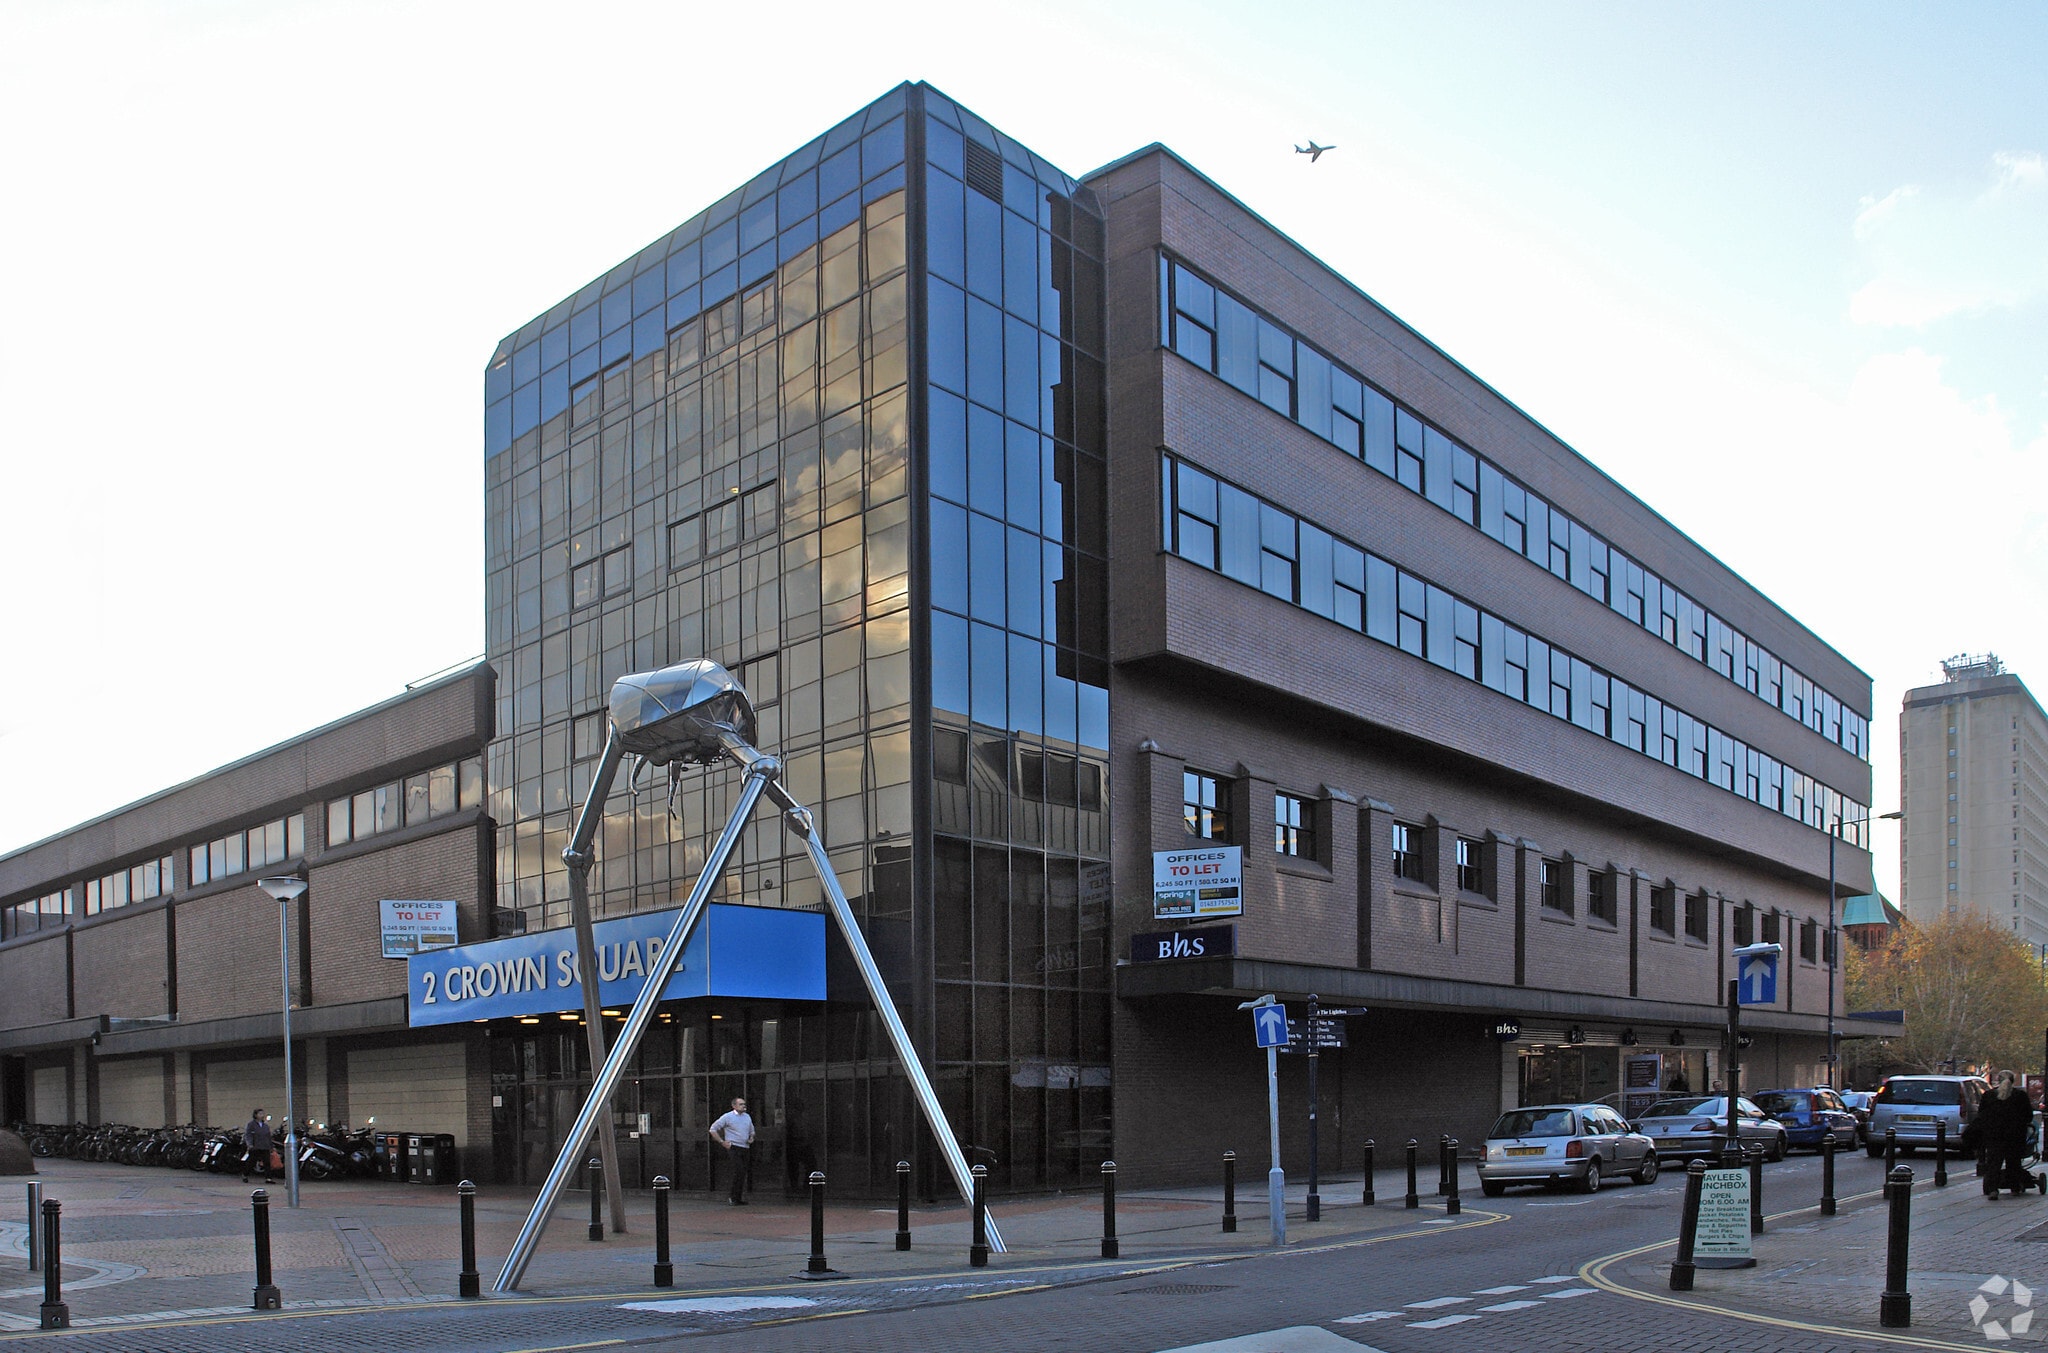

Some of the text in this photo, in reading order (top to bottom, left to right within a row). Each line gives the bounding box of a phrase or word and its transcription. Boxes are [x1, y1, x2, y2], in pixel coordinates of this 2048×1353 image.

[1167, 852, 1226, 863] OFFICES
[1170, 864, 1222, 876] TO LET
[1159, 891, 1184, 900] spring
[396, 912, 441, 920] TO LET
[423, 971, 437, 1004] 2
[444, 954, 546, 1002] CROWN
